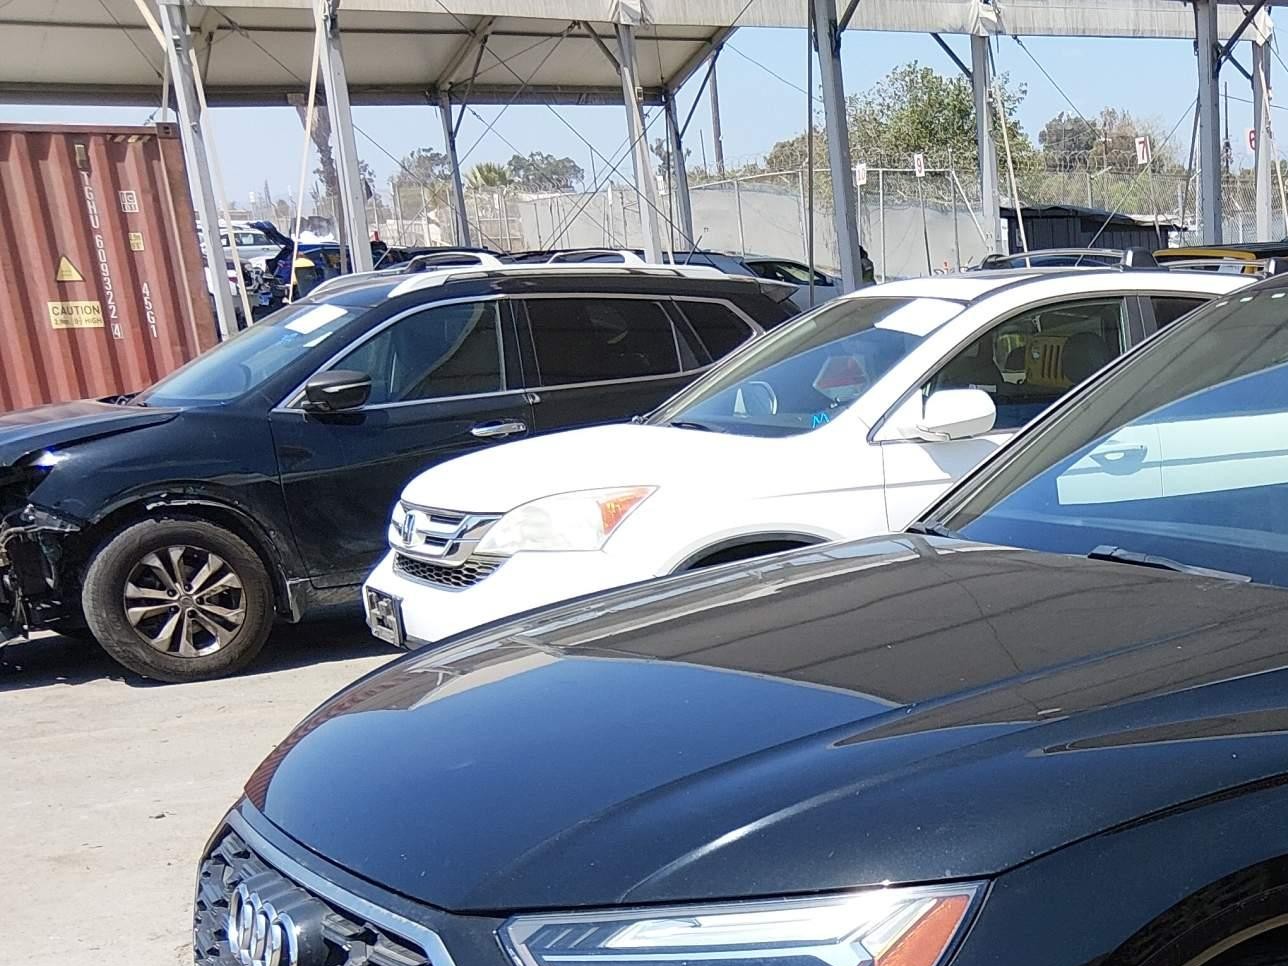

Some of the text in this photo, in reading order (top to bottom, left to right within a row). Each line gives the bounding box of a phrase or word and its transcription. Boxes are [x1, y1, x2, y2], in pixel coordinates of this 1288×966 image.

[1138, 140, 1148, 160] 7
[916, 157, 923, 173] 9
[80, 171, 122, 338] TGHU 609322 4
[51, 305, 100, 316] CAUTION
[142, 282, 158, 338] 45G1
